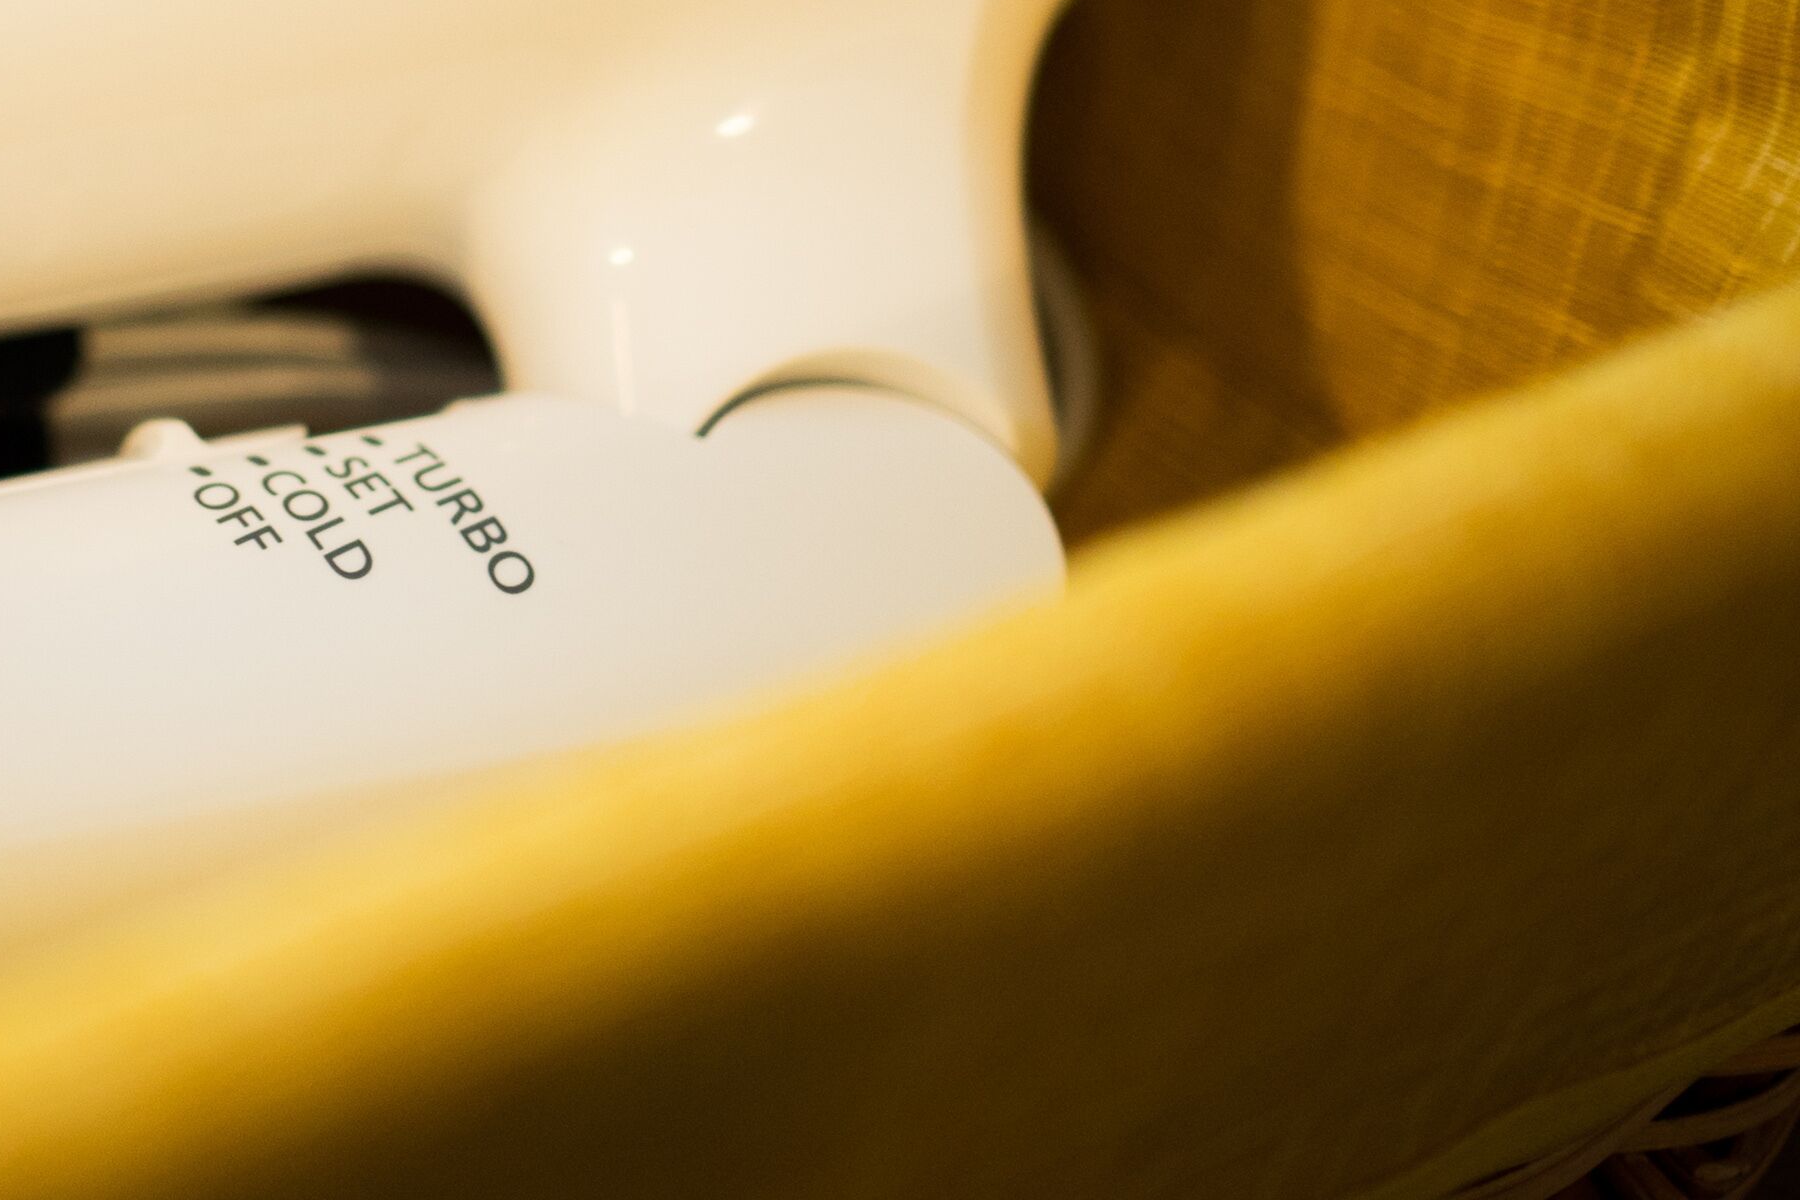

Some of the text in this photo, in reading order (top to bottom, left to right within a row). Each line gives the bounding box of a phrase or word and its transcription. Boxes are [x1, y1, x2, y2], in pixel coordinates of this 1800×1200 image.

[193, 482, 283, 550] OFF
[261, 470, 373, 580] COLD
[324, 455, 414, 516] SET
[394, 442, 535, 595] TURBO
